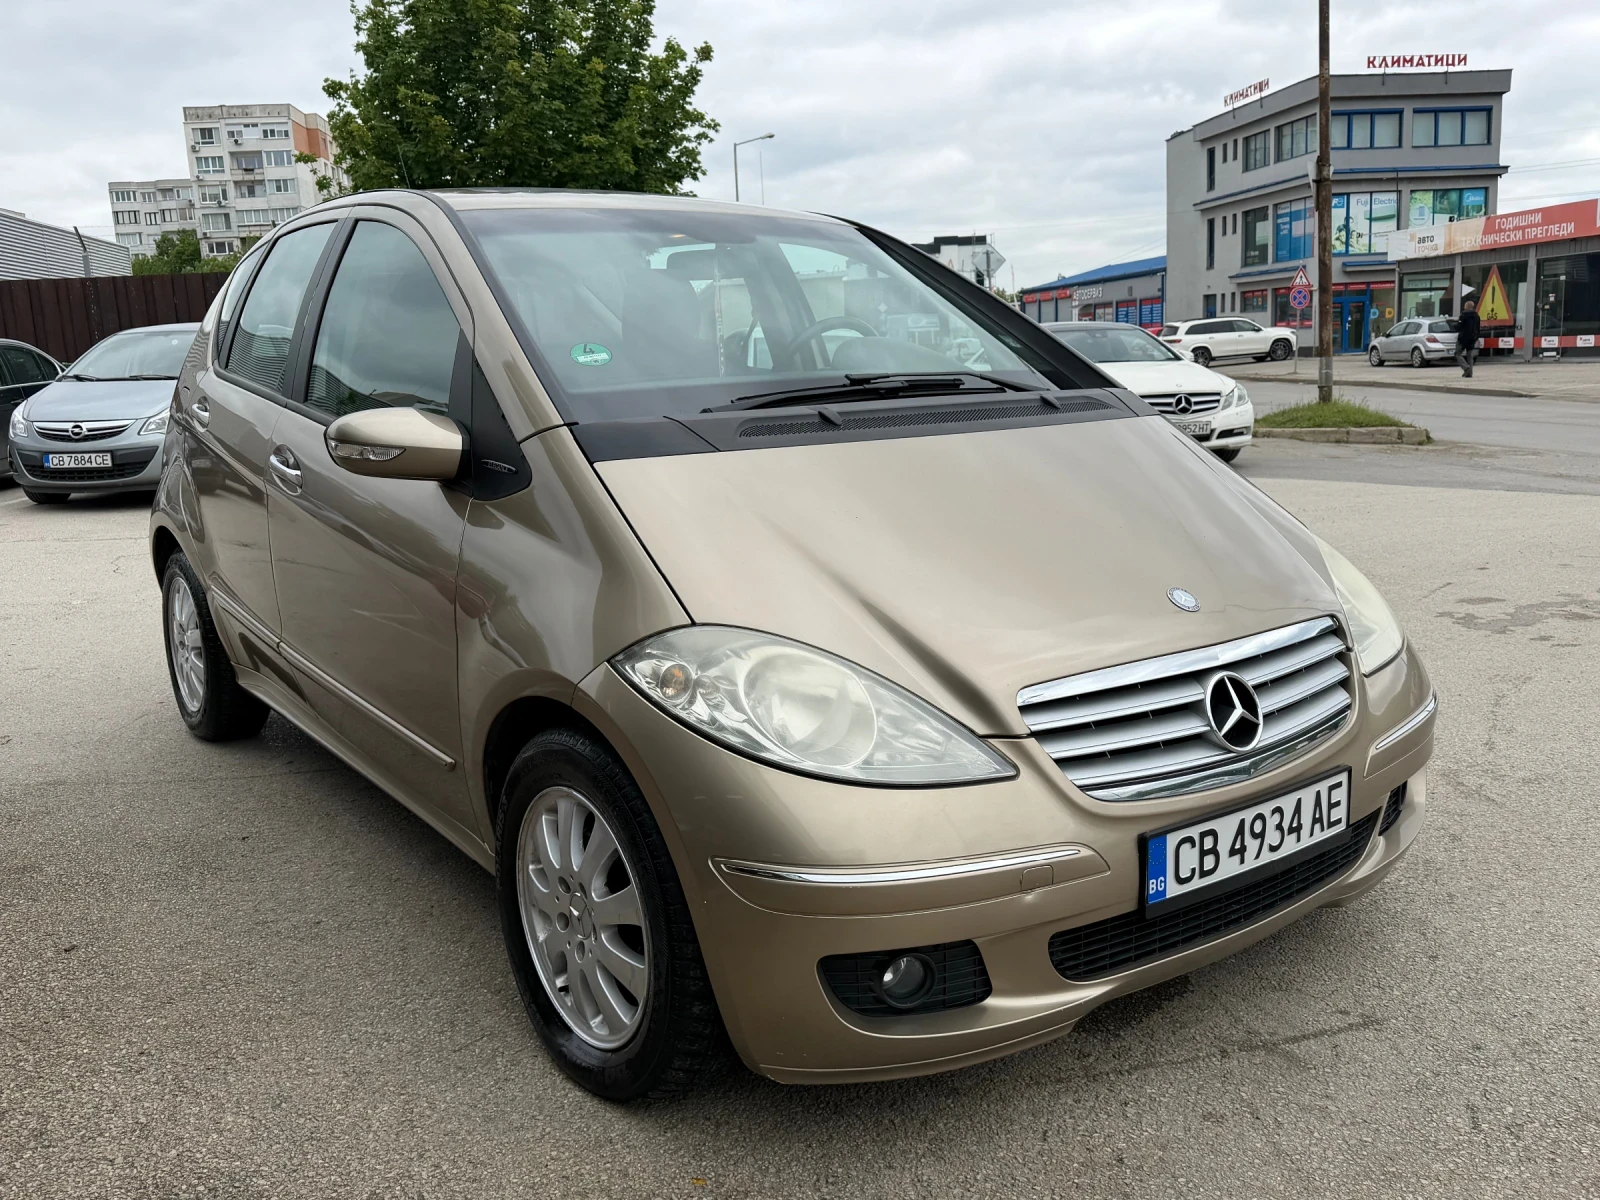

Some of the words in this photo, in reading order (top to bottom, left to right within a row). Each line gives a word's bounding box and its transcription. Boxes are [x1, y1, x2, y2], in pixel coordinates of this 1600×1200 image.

[1367, 54, 1467, 68] КЛИМАТИЦИ
[1224, 78, 1269, 107] КЛИМАТИЦИ
[1357, 198, 1369, 207] Fuji
[1495, 212, 1542, 230] ГОДИШНИ
[1525, 222, 1574, 239] ПРЕГЛЕДИ
[1417, 235, 1434, 245] авто
[1418, 244, 1438, 253] точка
[1487, 312, 1498, 320] GAS
[583, 344, 595, 354] 4
[1199, 423, 1209, 432] HT
[51, 455, 65, 466] CB
[67, 455, 93, 466] 7884
[95, 455, 109, 466] CE
[1174, 828, 1220, 885] CB
[1228, 797, 1303, 865] 4934
[1309, 780, 1343, 838] AE
[1149, 876, 1165, 894] BG
